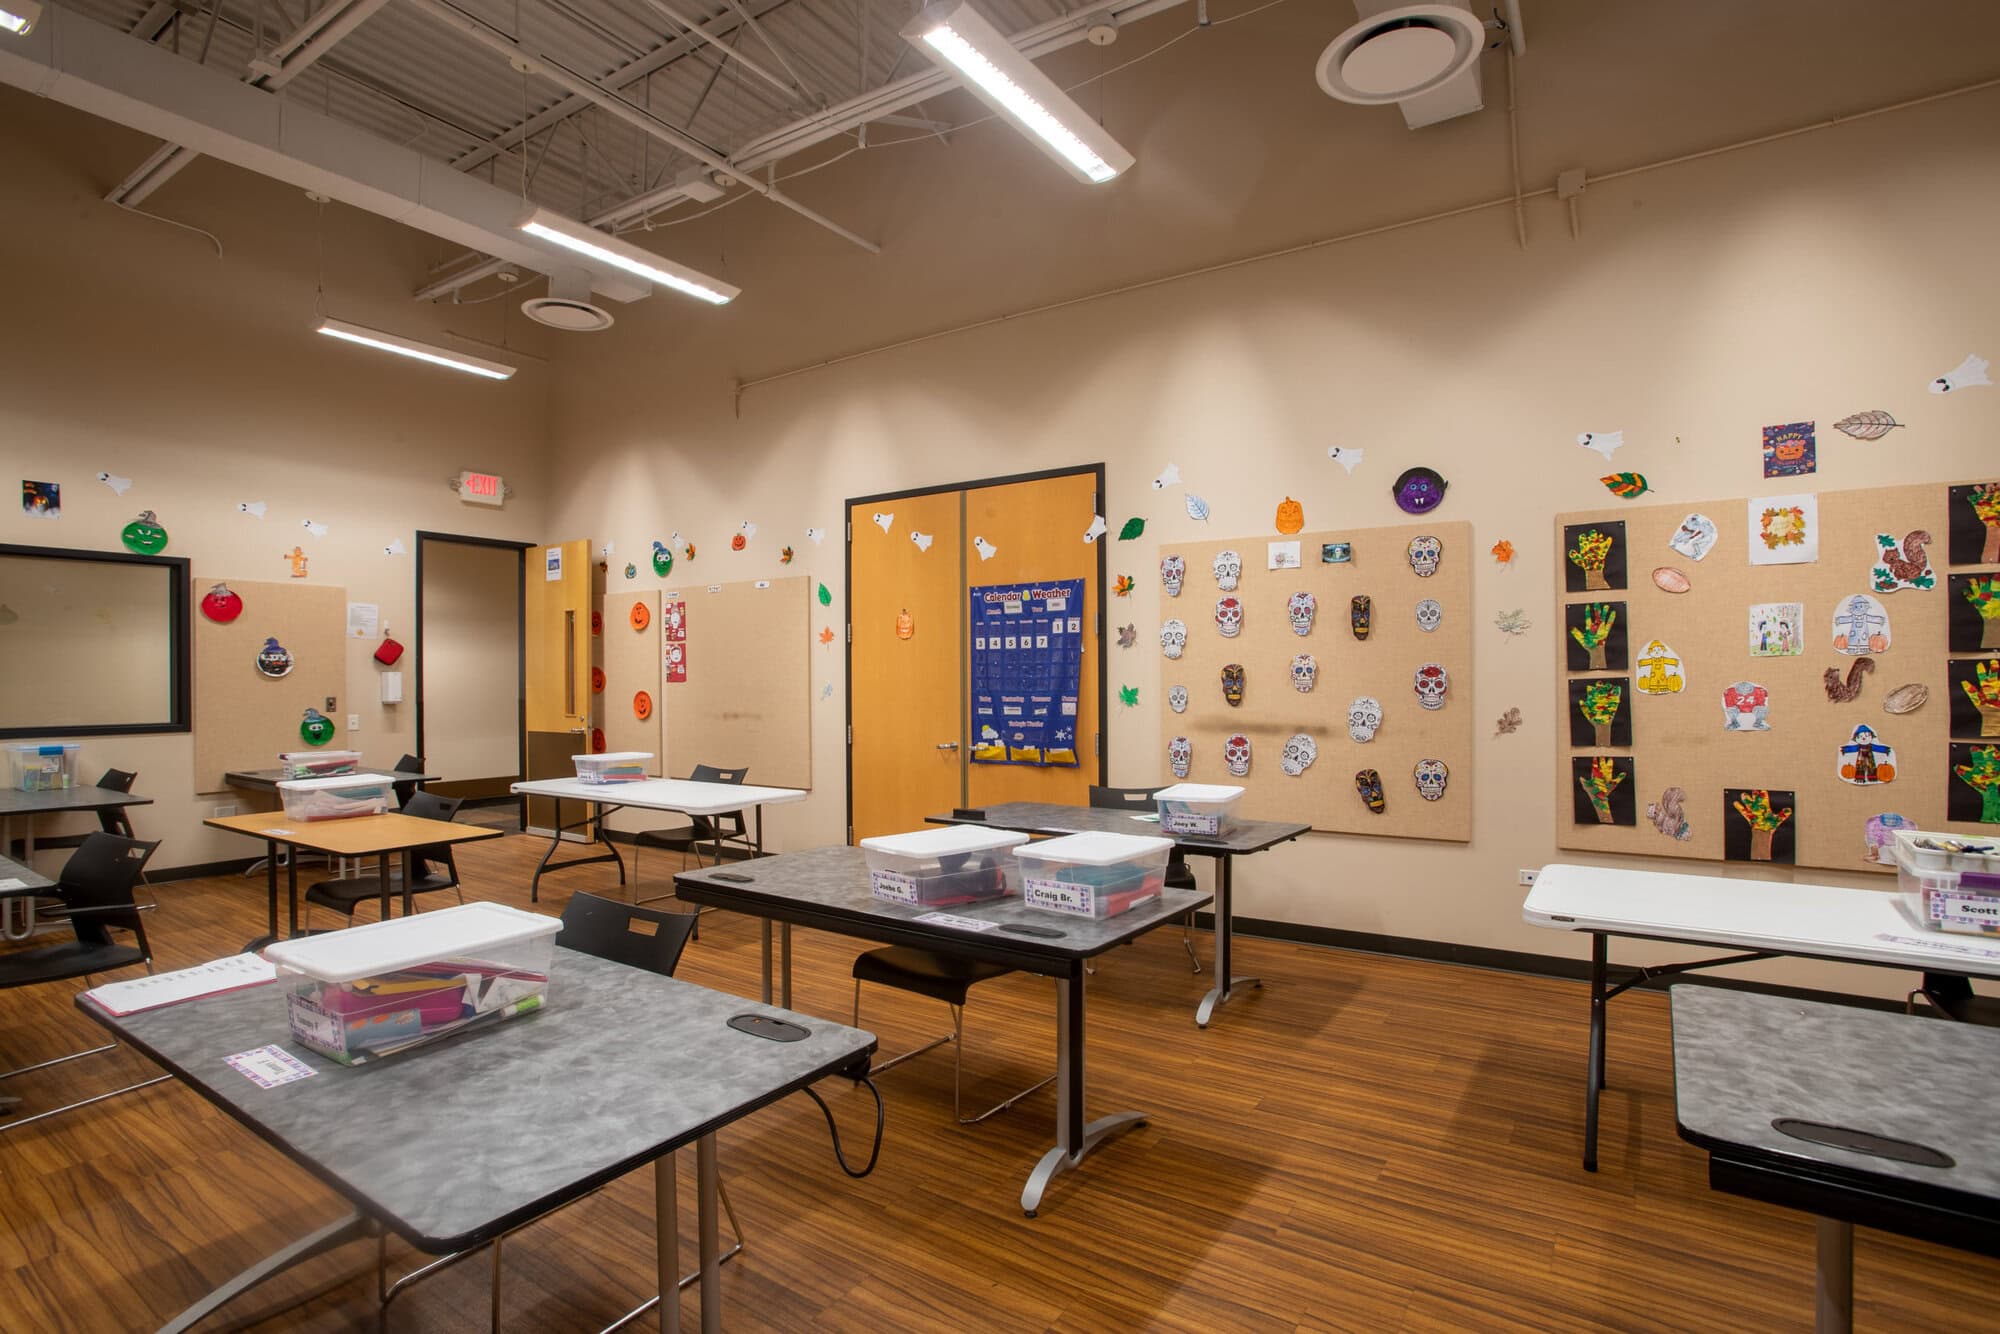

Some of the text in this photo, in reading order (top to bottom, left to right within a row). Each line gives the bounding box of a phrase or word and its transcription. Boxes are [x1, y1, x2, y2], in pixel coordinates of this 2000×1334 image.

[470, 473, 497, 496] EXIT
[983, 588, 1071, 603] Calendar Weather
[1736, 695, 1755, 705] 24
[1034, 889, 1058, 901] Craig
[1961, 904, 1998, 915] Scott
